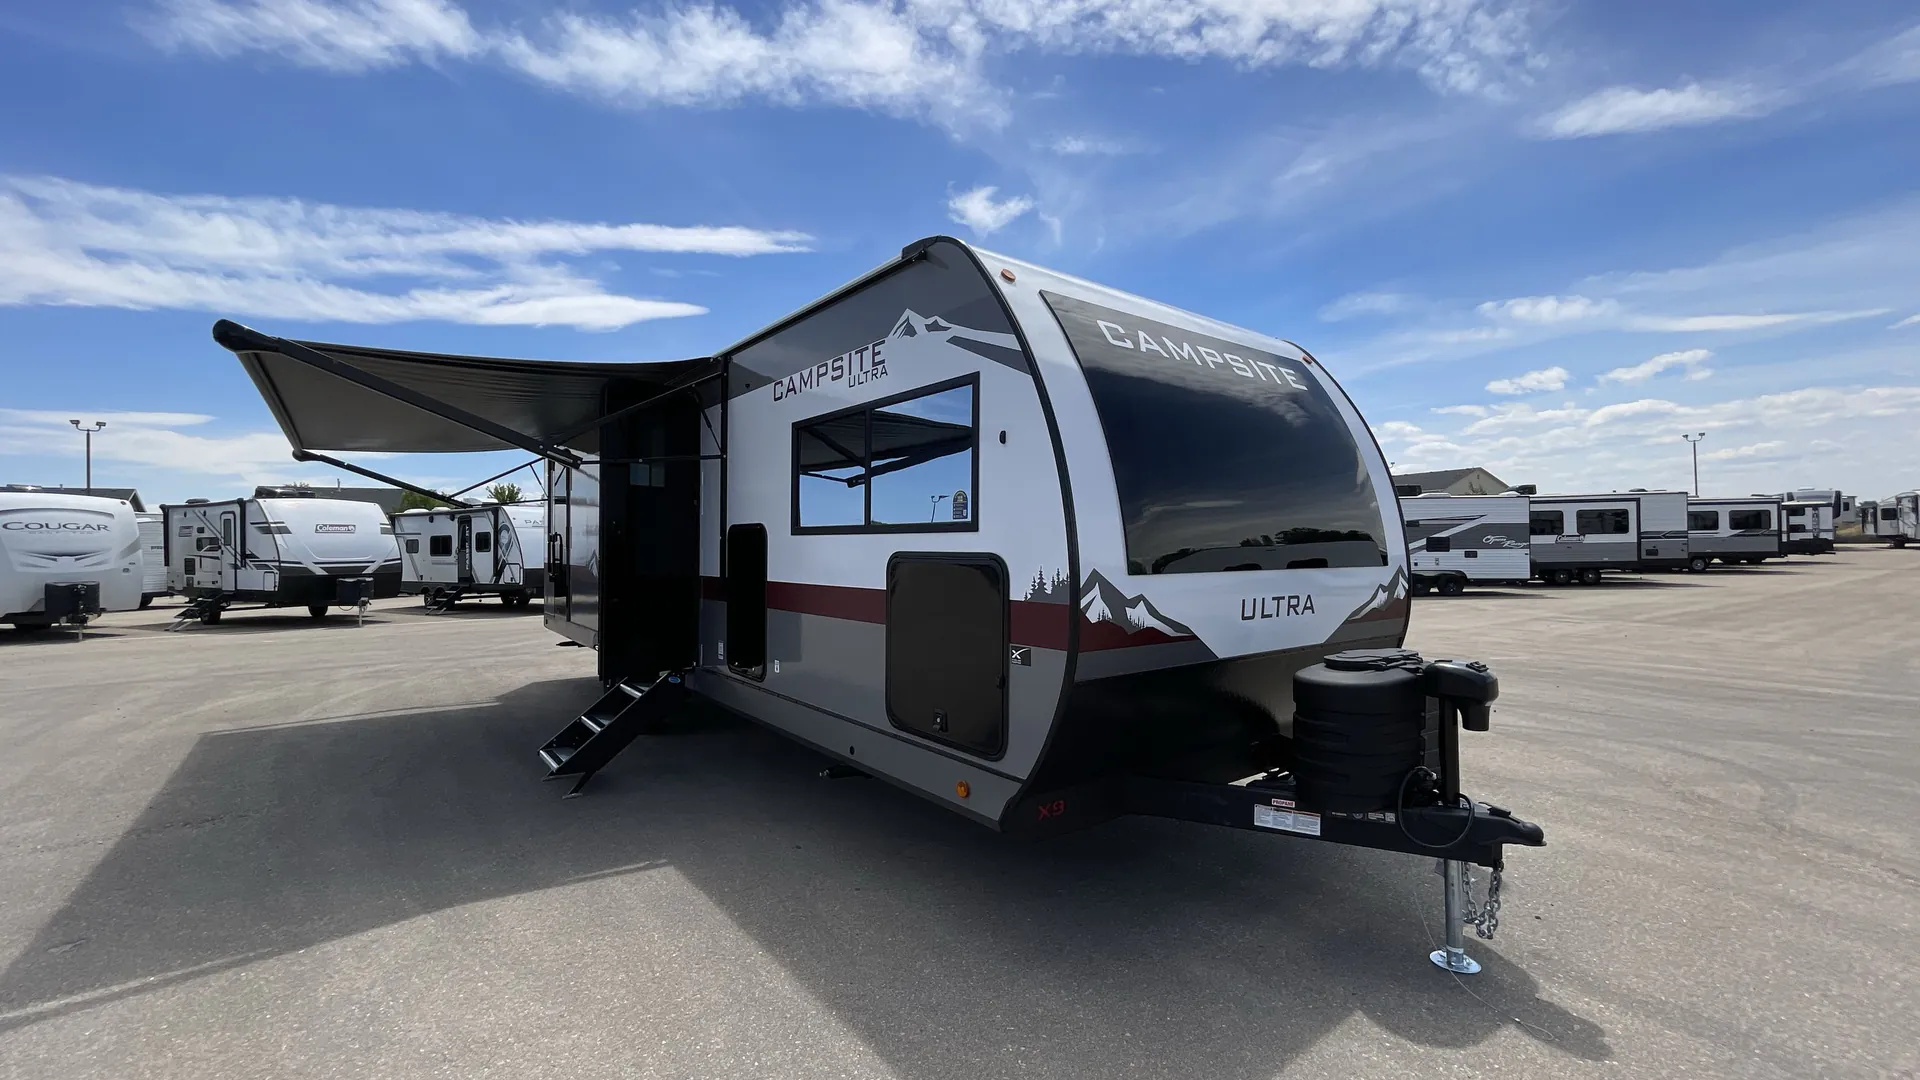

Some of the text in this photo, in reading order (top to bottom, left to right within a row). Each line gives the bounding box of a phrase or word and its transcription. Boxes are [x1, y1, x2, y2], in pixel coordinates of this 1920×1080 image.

[1096, 319, 1308, 391] CAMPSITE
[773, 339, 887, 402] CAMPSITE
[848, 365, 888, 388] ULTRA
[2, 521, 110, 532] COUGAR
[316, 524, 348, 532] Coleman
[1240, 594, 1315, 621] ULTRA
[1272, 799, 1294, 807] PROPANE
